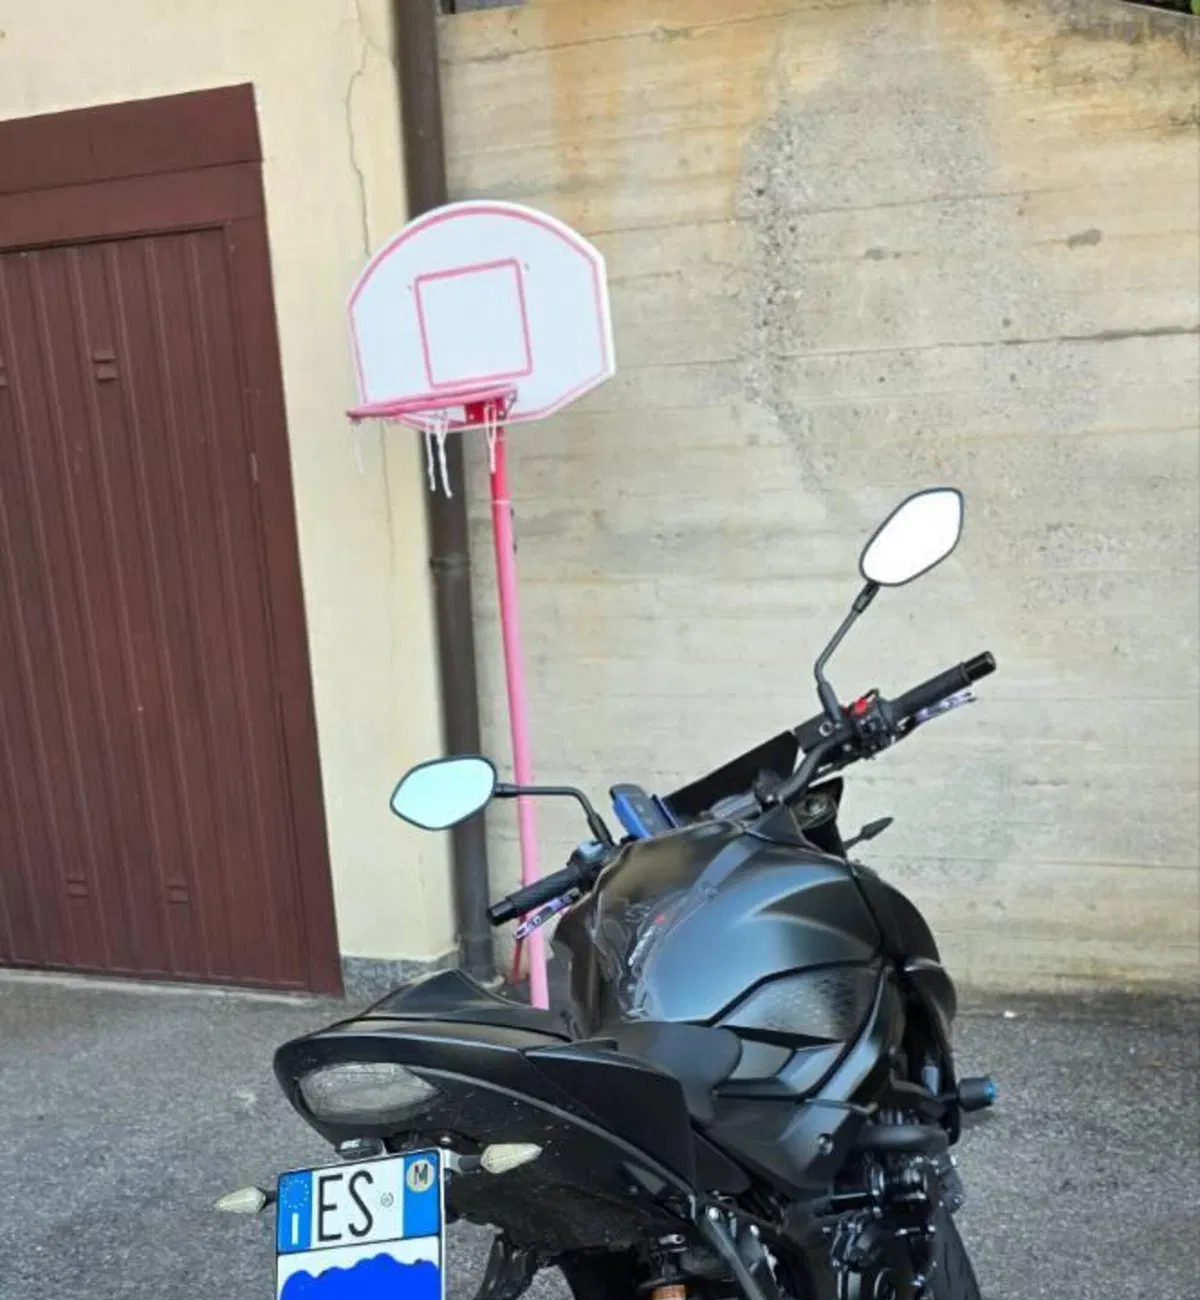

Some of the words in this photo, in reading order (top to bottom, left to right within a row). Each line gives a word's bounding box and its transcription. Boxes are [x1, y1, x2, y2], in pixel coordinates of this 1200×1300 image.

[292, 1213, 299, 1245] I
[318, 1170, 374, 1242] ES
[414, 1163, 429, 1185] M
